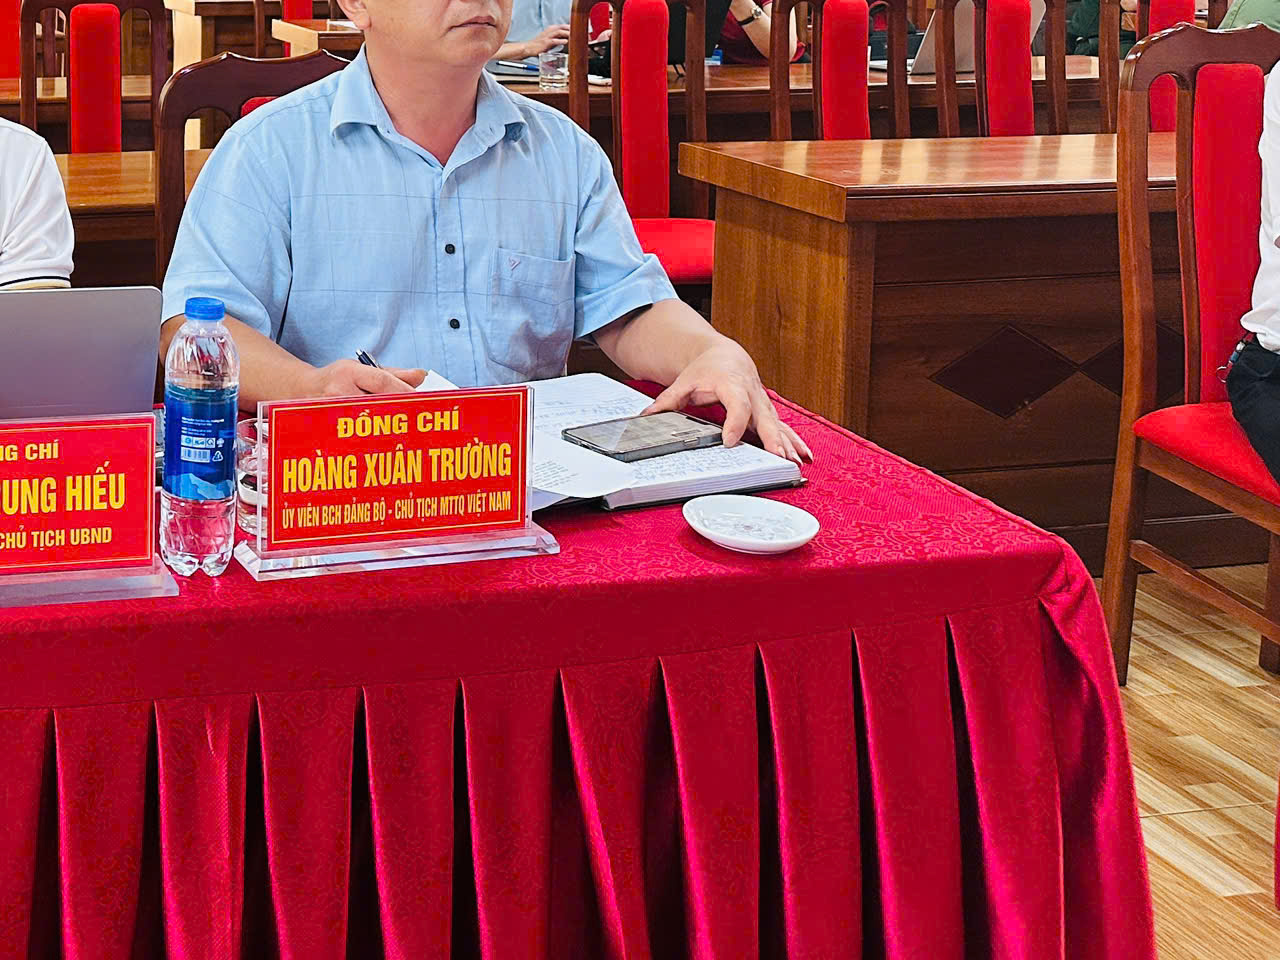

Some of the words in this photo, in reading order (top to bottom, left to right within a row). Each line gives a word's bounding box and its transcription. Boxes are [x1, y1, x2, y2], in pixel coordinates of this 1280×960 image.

[337, 409, 408, 438] ĐỒNG
[417, 406, 459, 433] CHÍ
[25, 440, 59, 459] CHÍ
[283, 450, 357, 493] HOÀNG
[364, 445, 422, 487] XUÂN
[429, 437, 511, 481] TRƯỜNG
[66, 461, 126, 510] HIẾU
[282, 500, 296, 529] ỦY
[297, 504, 320, 527] VIÊN
[322, 506, 341, 526] BCH
[344, 499, 371, 524] ĐẢNG
[373, 499, 386, 526] BỘ
[395, 492, 414, 520] CHỦ
[416, 496, 437, 523] TỊCH
[439, 497, 465, 517] MTTQ
[466, 490, 487, 517] VIỆT
[489, 491, 510, 512] NAM
[31, 529, 65, 549] TỊCH
[70, 527, 112, 545] UBND
